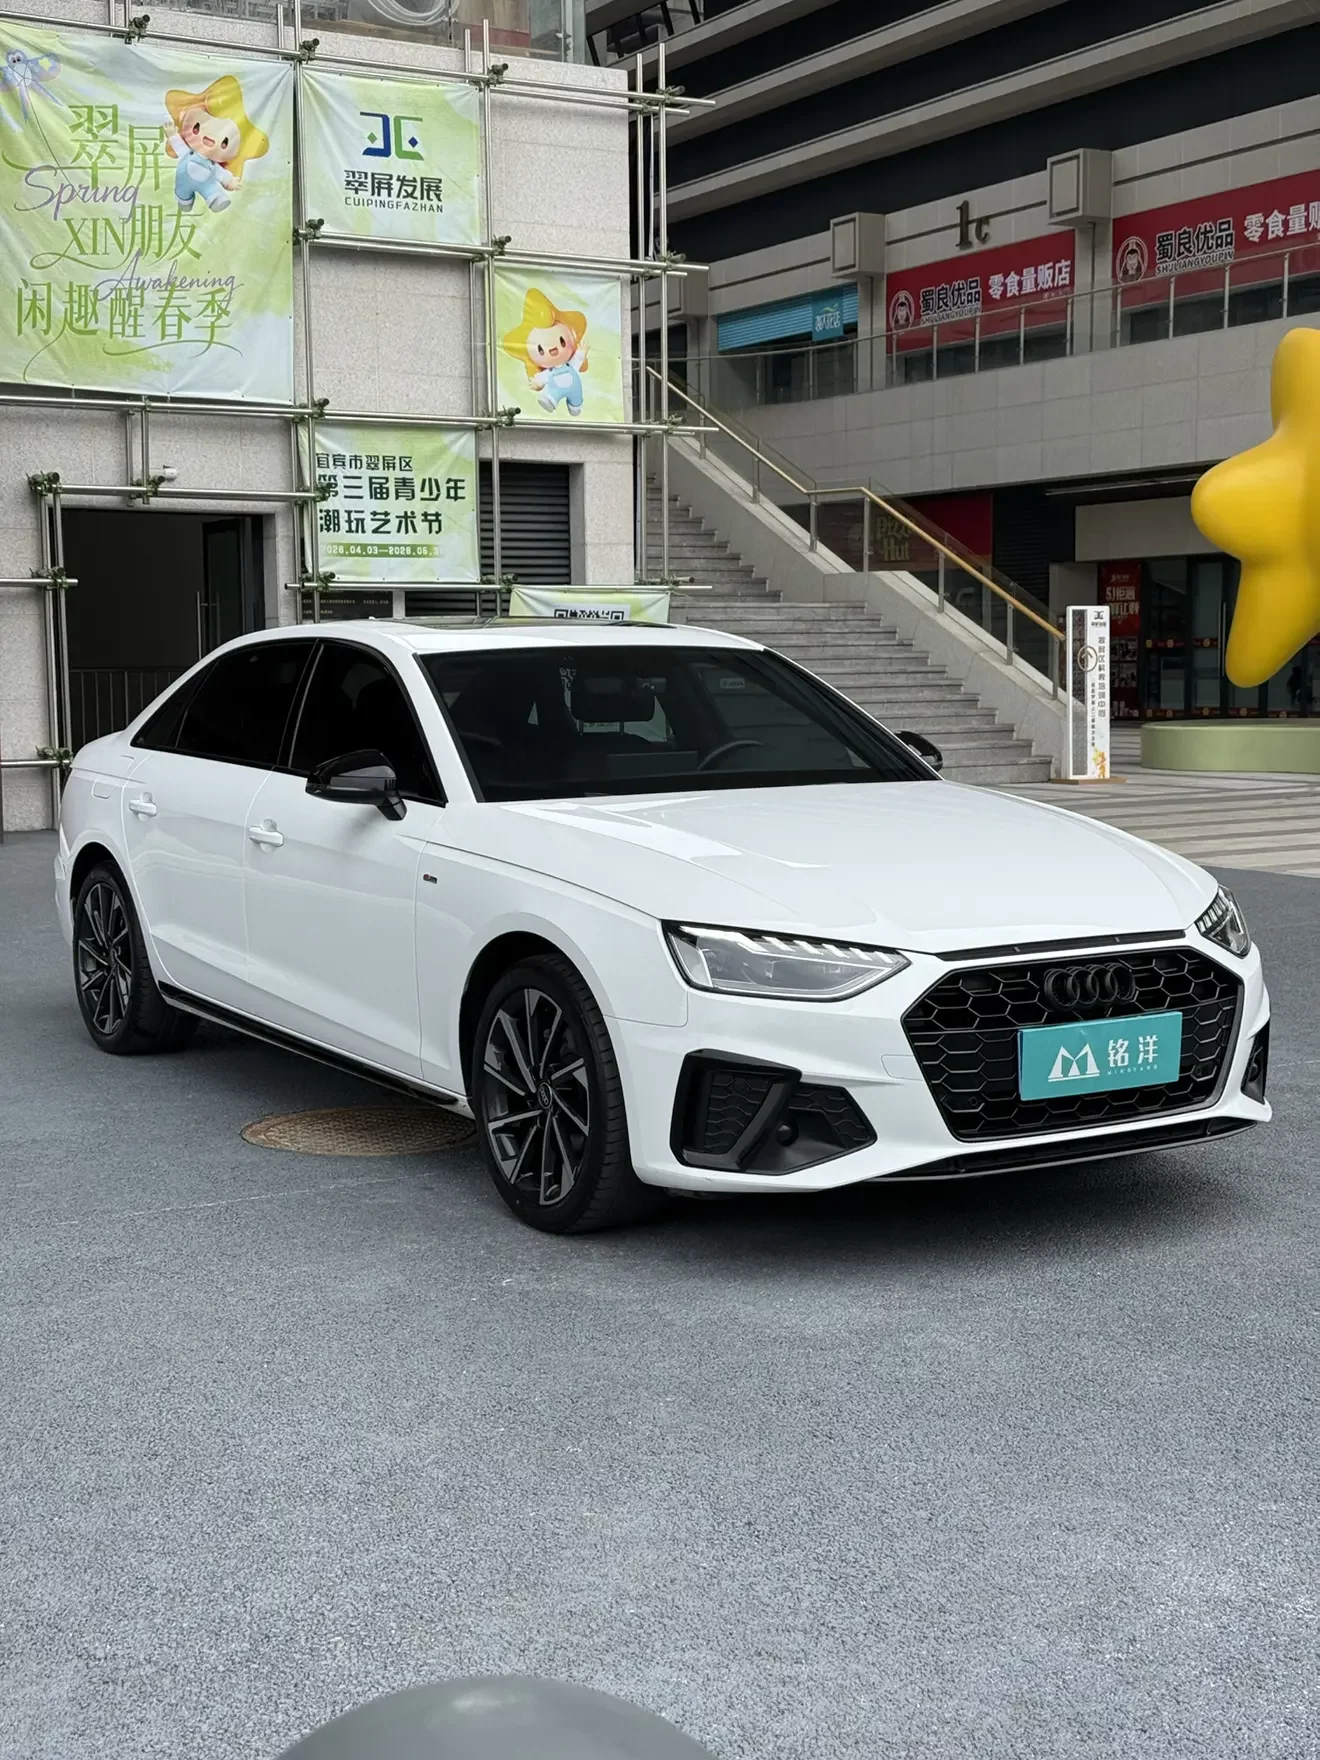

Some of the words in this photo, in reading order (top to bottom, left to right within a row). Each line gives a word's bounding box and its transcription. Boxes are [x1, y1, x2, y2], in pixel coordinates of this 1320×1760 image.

[67, 104, 170, 192] 翠屏
[14, 164, 140, 222] Spring
[344, 169, 443, 203] 翠屏发展
[344, 196, 444, 214] CUIPINGFAZHAN
[55, 204, 203, 264] XIN朋友
[1155, 217, 1235, 262] 蜀良优品
[96, 248, 244, 311] Awakening
[920, 277, 981, 316] 蜀良优品
[988, 259, 1071, 300] 零食量贩店
[16, 277, 235, 348] 闲趣醒春季
[315, 452, 413, 473] 宜宾市翠屏区
[317, 474, 466, 502] 第三届青少年
[318, 508, 443, 535] 潮玩艺术节
[1107, 1034, 1158, 1067] 铭洋
